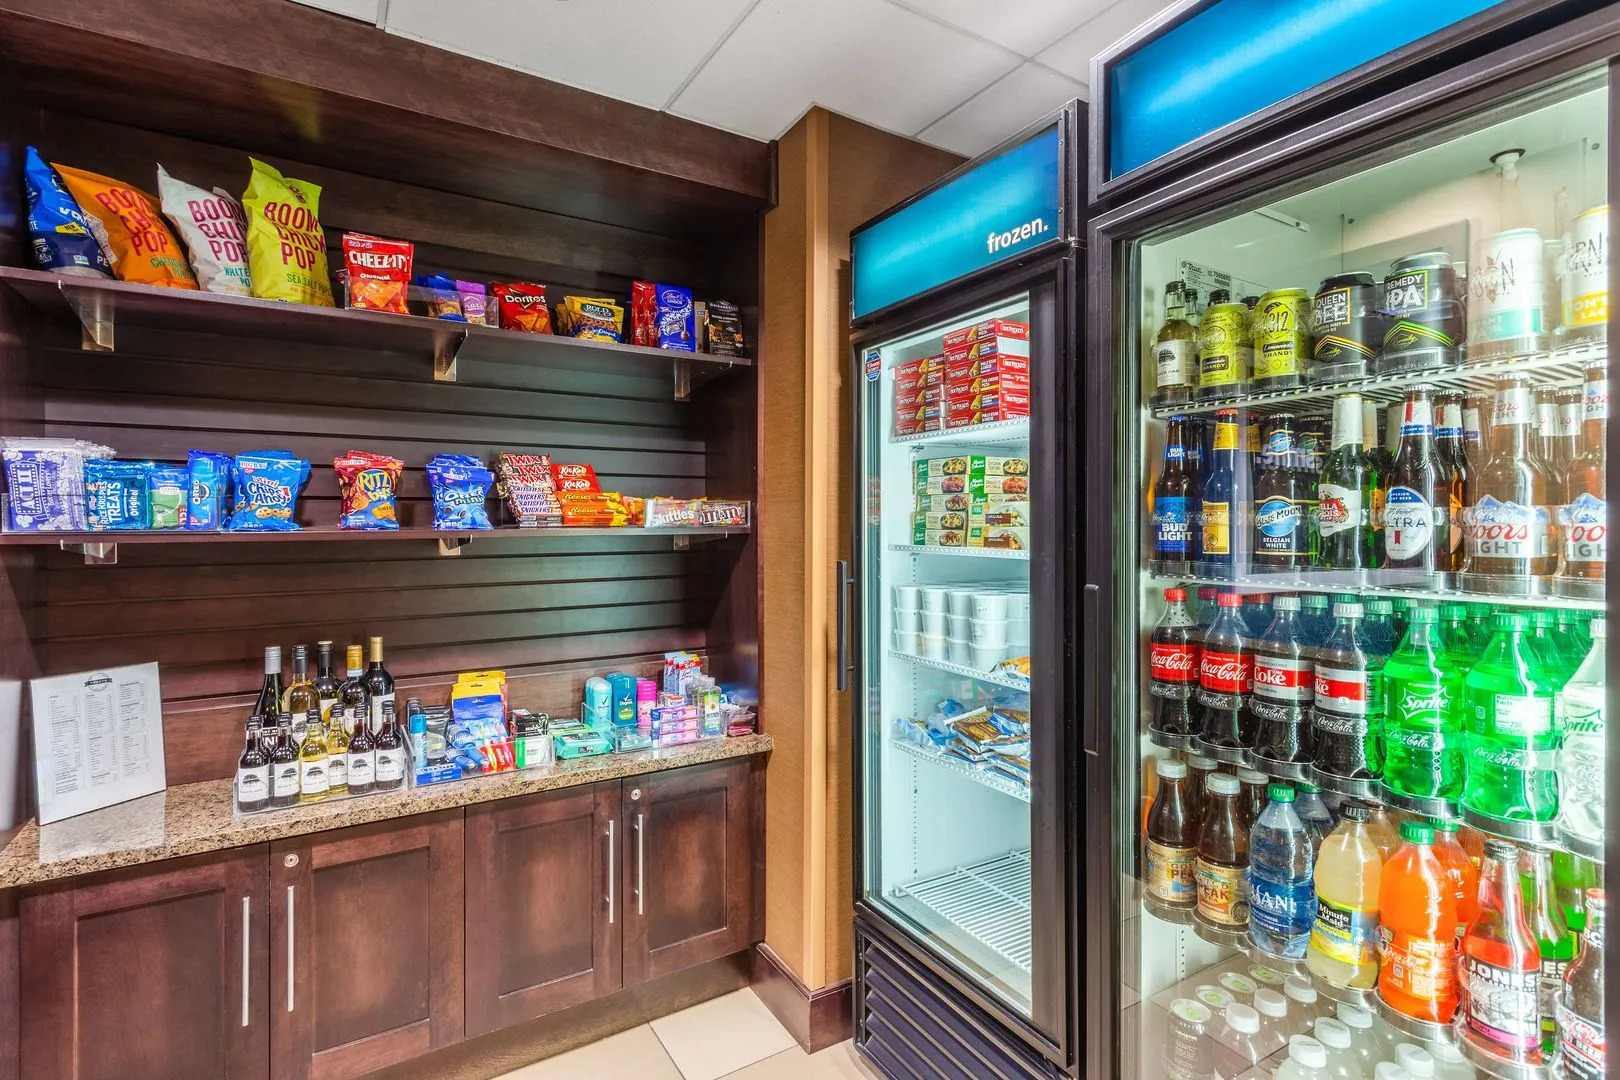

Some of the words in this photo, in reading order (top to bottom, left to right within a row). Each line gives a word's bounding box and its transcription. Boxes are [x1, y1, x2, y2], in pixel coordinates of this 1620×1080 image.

[264, 202, 320, 232] BOOM
[131, 230, 169, 256] POP
[987, 217, 1048, 254] frozen.
[280, 242, 316, 271] POP
[348, 251, 405, 271] CHEEZ-IT
[287, 274, 302, 285] SEA
[1387, 274, 1423, 289] REMEDY
[505, 295, 546, 304] Doritos
[1316, 293, 1346, 309] QUEEN
[503, 453, 540, 465] TWIX
[515, 465, 549, 475] TWIX
[359, 472, 390, 491] RITZ
[511, 475, 545, 484] TWIX
[193, 479, 201, 505] OREO
[247, 482, 282, 496] Chips
[107, 482, 122, 522] TREATS
[1276, 506, 1302, 518] MOON
[1158, 532, 1193, 541] LIGHT
[1162, 523, 1188, 532] BUD
[1151, 651, 1193, 670] Coca-Cola
[1201, 659, 1248, 680] Coca-Cola
[1254, 666, 1287, 686] Coke
[1315, 677, 1329, 696] ke
[1402, 695, 1449, 711] Sprite
[1561, 716, 1604, 733] Sprite
[1319, 903, 1350, 923] Minute
[1321, 912, 1345, 929] Maid
[1469, 960, 1537, 989] JONES
